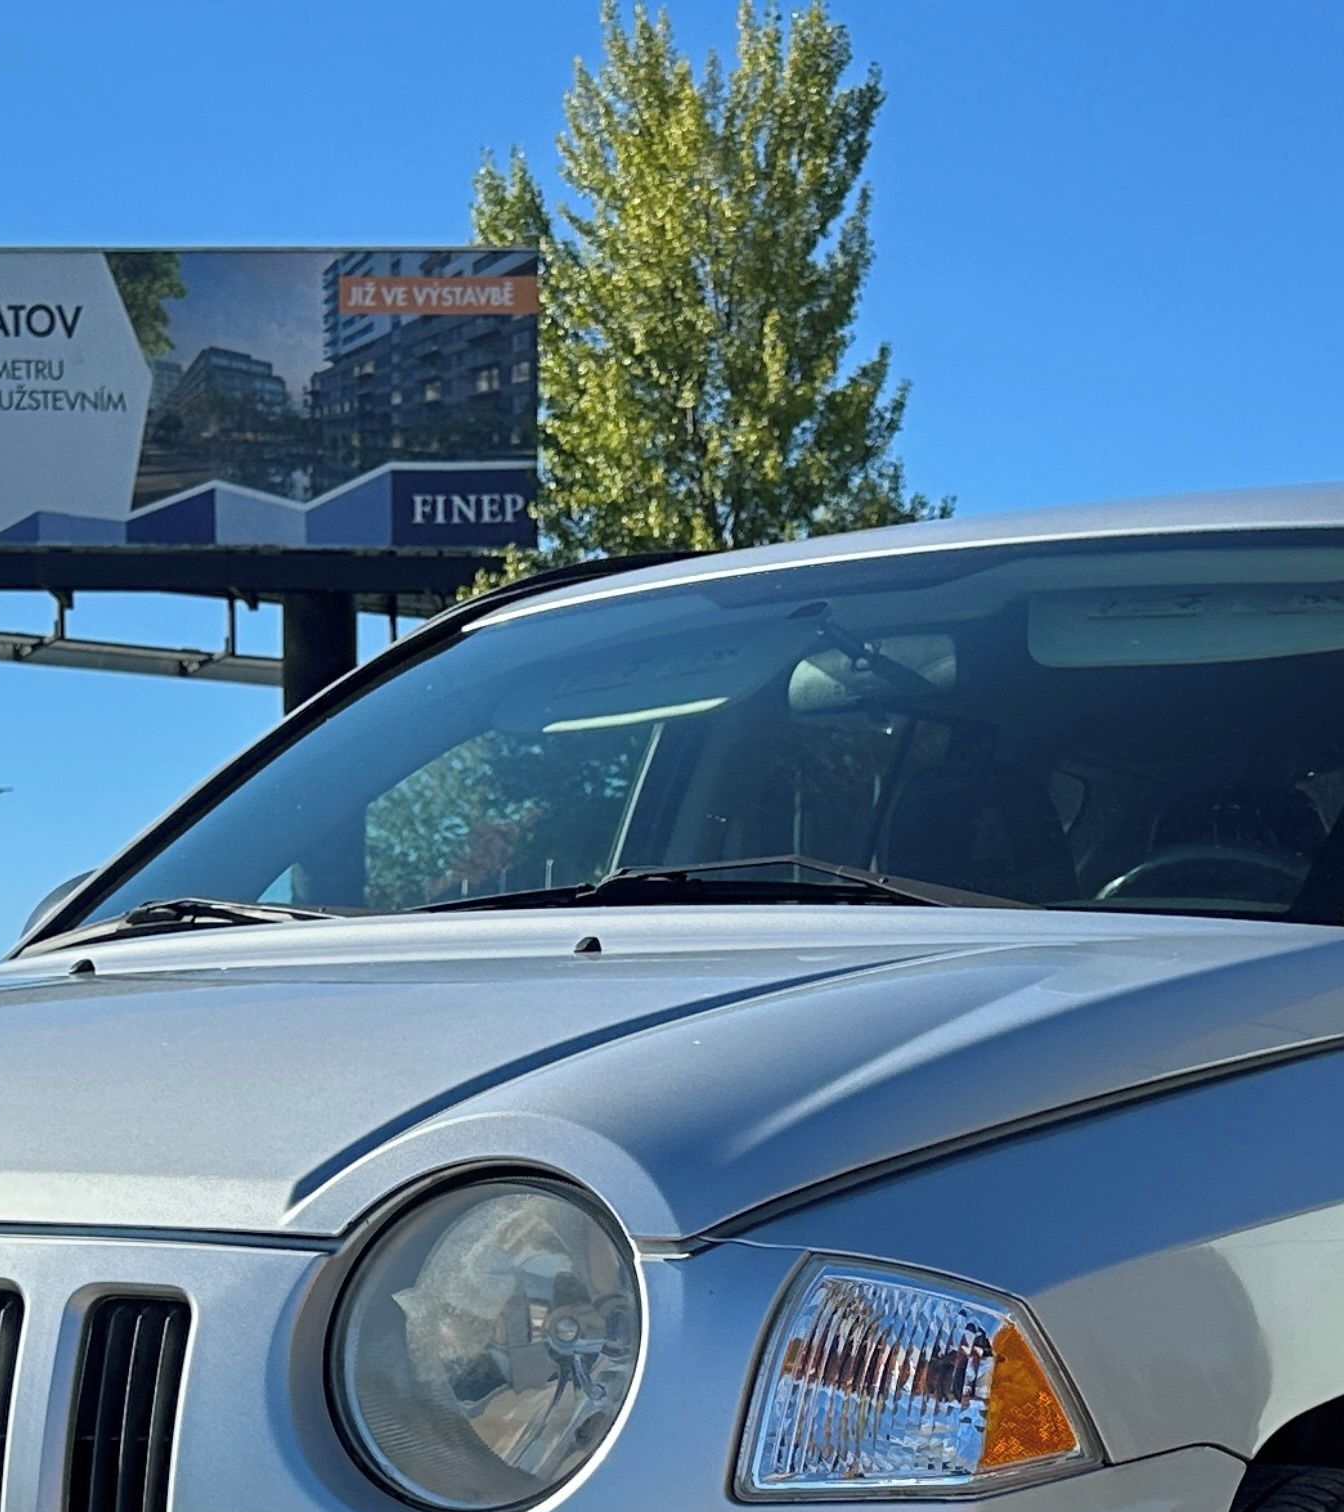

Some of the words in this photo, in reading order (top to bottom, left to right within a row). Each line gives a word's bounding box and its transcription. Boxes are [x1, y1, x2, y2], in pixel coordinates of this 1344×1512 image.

[348, 281, 377, 307] JIŽ
[381, 286, 408, 307] VE
[412, 281, 515, 307] VÝSTAVBĚ
[412, 493, 526, 524] FINEP
